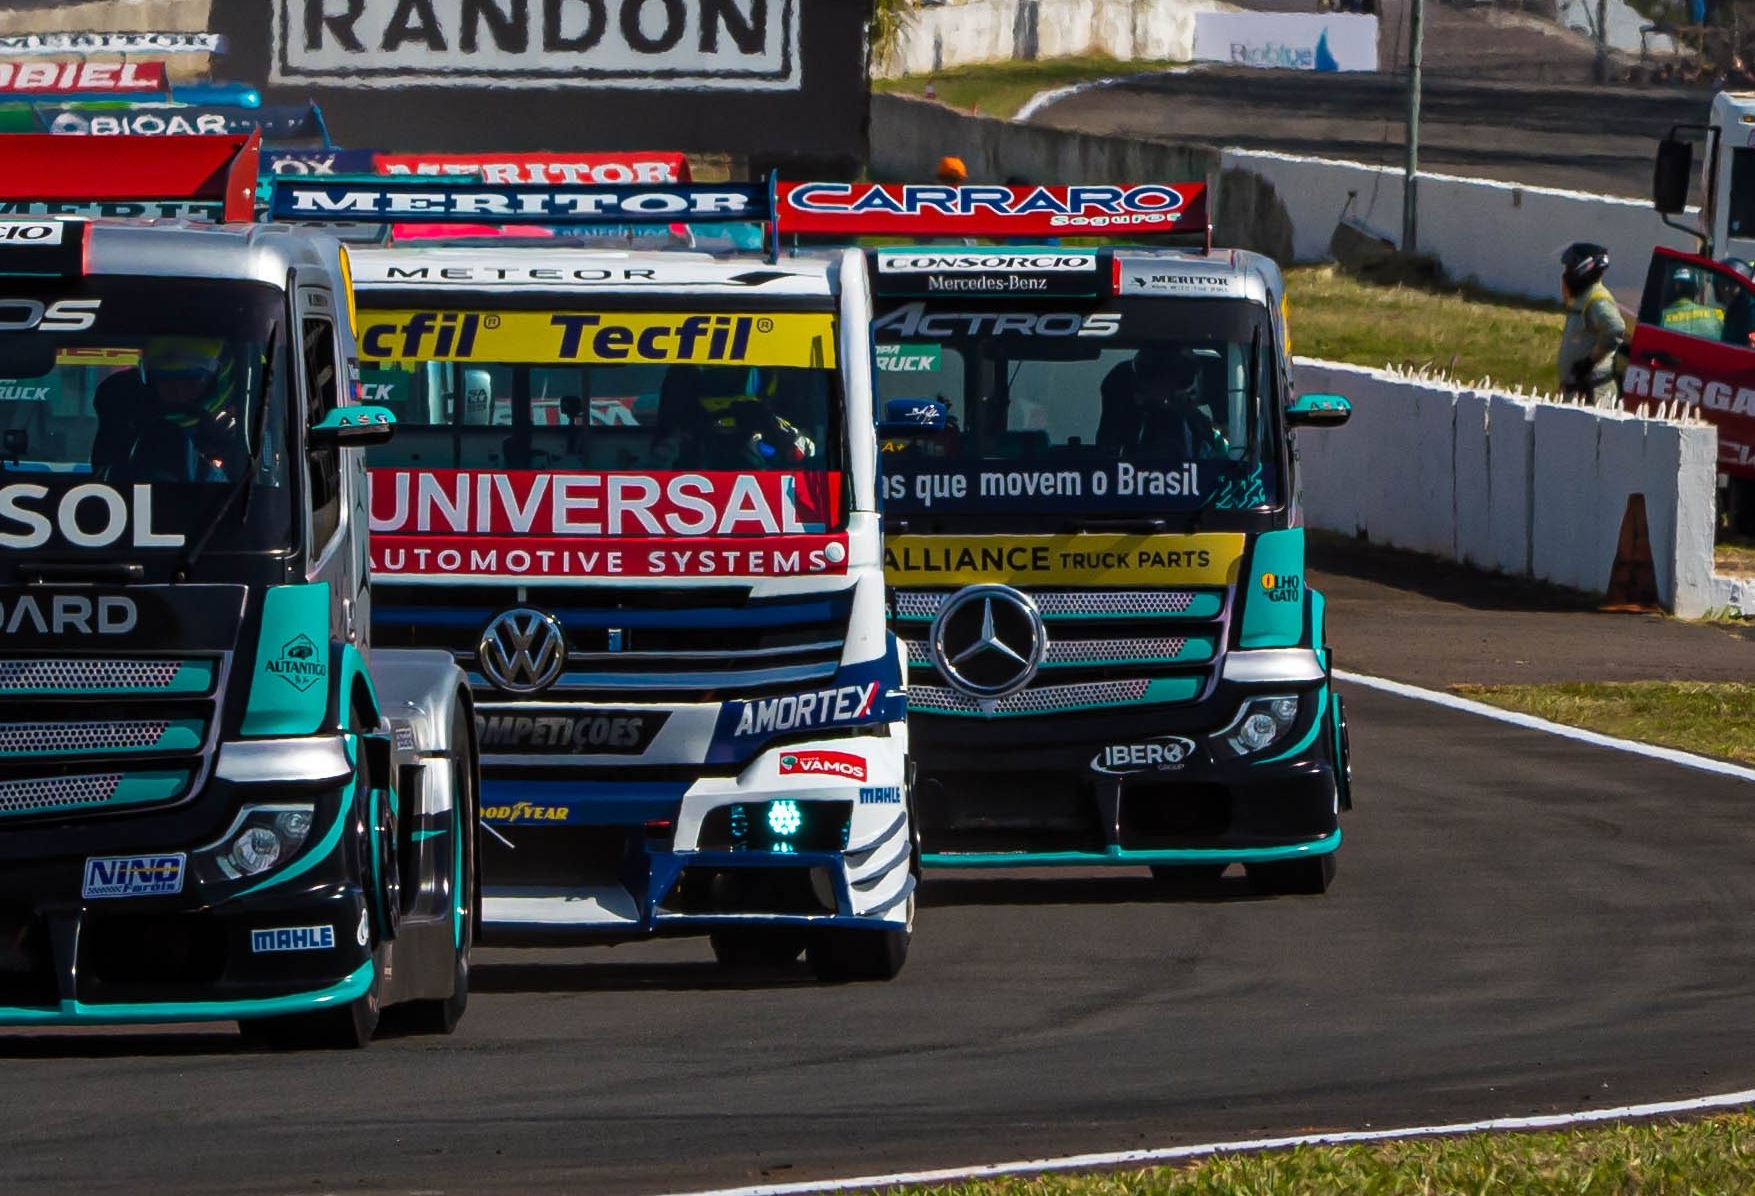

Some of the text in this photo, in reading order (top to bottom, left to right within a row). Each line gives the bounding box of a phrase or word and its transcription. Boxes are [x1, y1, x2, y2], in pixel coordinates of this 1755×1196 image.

[292, 190, 752, 213] MERITOR
[786, 182, 1183, 216] CARRARO
[386, 267, 657, 281] METEOR
[928, 275, 1048, 291] Mercedes-Benz
[1151, 275, 1229, 286] MERITOR
[550, 312, 754, 361] Tecfil
[915, 474, 967, 507] que
[979, 471, 1082, 496] movem
[1092, 470, 1108, 496] o
[1117, 462, 1200, 496] Brasil
[368, 472, 826, 534] UNIVERSAL
[369, 548, 826, 573] UTOMOTIVE SYSTEMS
[883, 546, 1210, 572] ALLIANCE TRUCK PARTS
[1269, 589, 1299, 602] GATO
[264, 660, 327, 677] AUTANTIGO
[733, 680, 880, 737] AMORTEX
[799, 760, 864, 778] VAMOS
[859, 787, 901, 804] MAHLE
[90, 858, 178, 886] NINO
[253, 927, 333, 950] MAHLE
